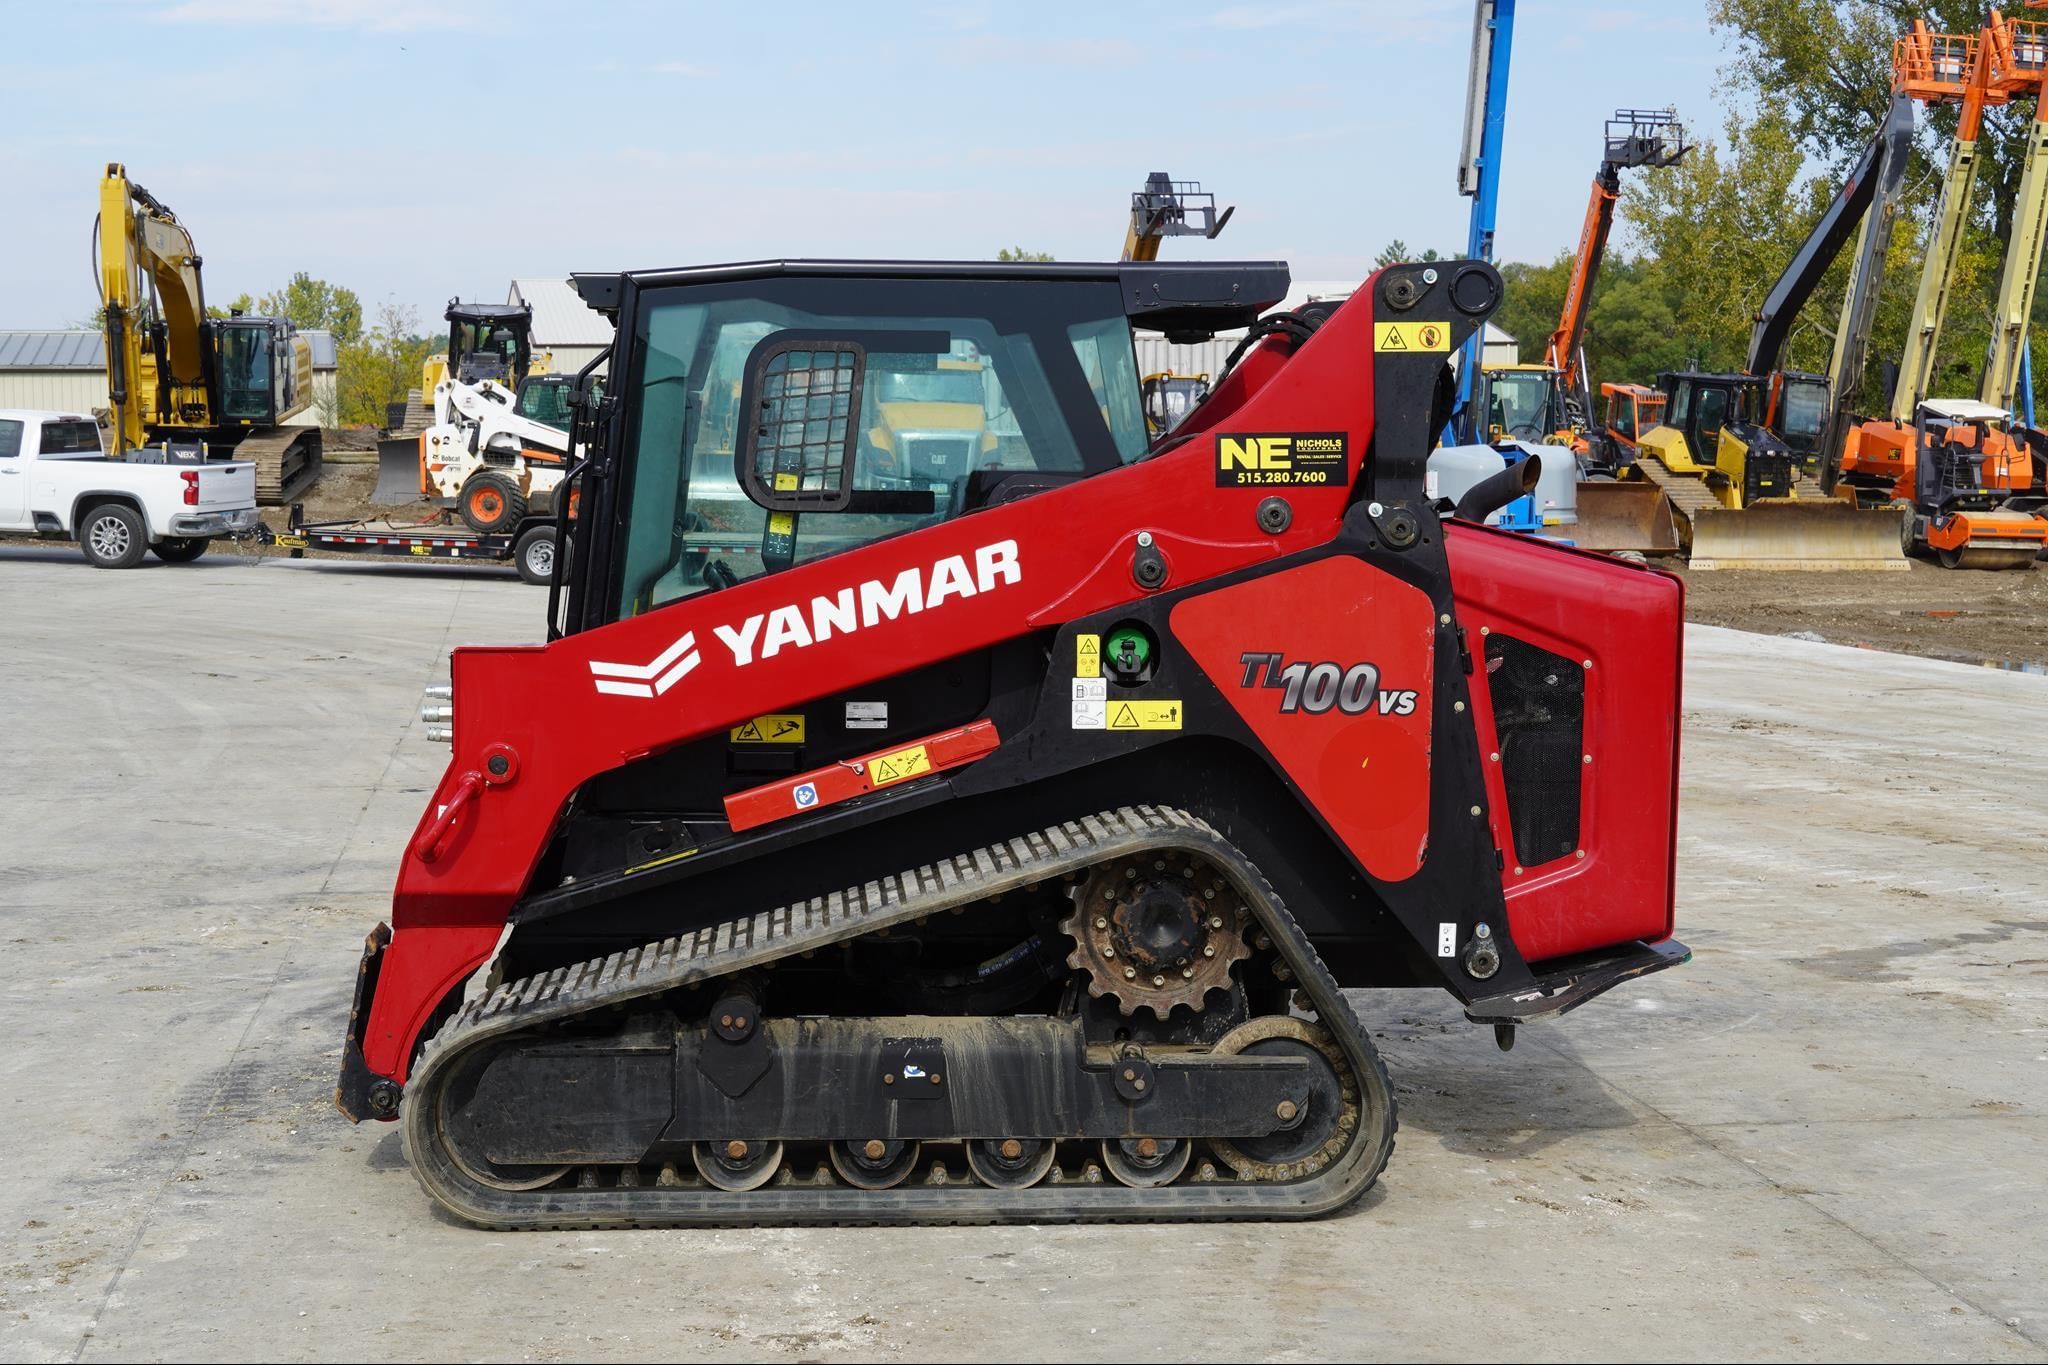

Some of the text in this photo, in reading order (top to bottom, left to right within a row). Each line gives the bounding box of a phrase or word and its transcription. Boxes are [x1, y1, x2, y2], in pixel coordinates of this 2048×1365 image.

[931, 454, 947, 465] CAT
[1220, 437, 1342, 470] NE NICHOLS
[1237, 471, 1326, 483] 515.280.7600
[713, 539, 1022, 667] YANMAR
